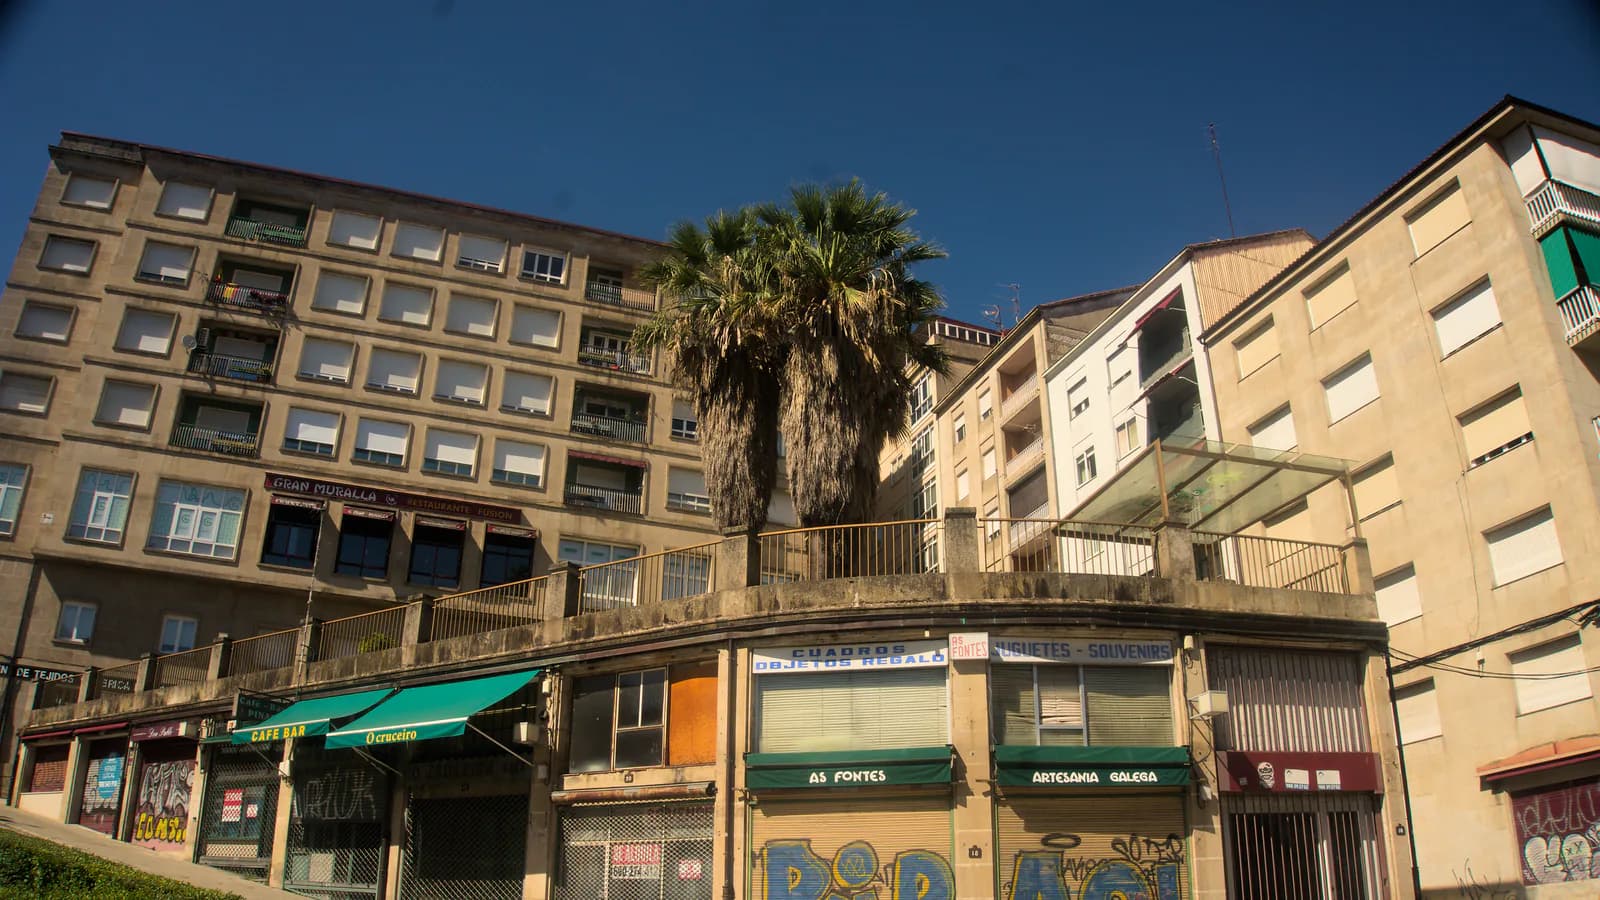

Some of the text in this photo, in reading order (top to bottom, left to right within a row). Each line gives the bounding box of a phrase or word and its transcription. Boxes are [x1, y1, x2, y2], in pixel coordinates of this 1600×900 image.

[272, 477, 377, 501] GRAN MURALLA
[478, 508, 513, 520] FUSION
[951, 636, 963, 646] AS
[792, 645, 905, 658] CUADROS
[952, 641, 988, 658] FONTES
[990, 641, 1071, 658] JUGUETES
[1089, 643, 1170, 660] SOUVENIRS
[755, 653, 945, 671] OBJETOS REGALO
[16, 667, 30, 678] DE
[34, 669, 74, 684] TEJIDOS
[251, 725, 306, 742] CAFE BAR
[366, 728, 417, 744] O cruceiro
[809, 770, 887, 784] AS FONTES
[1032, 771, 1158, 784] ARTESANIA GALEGA
